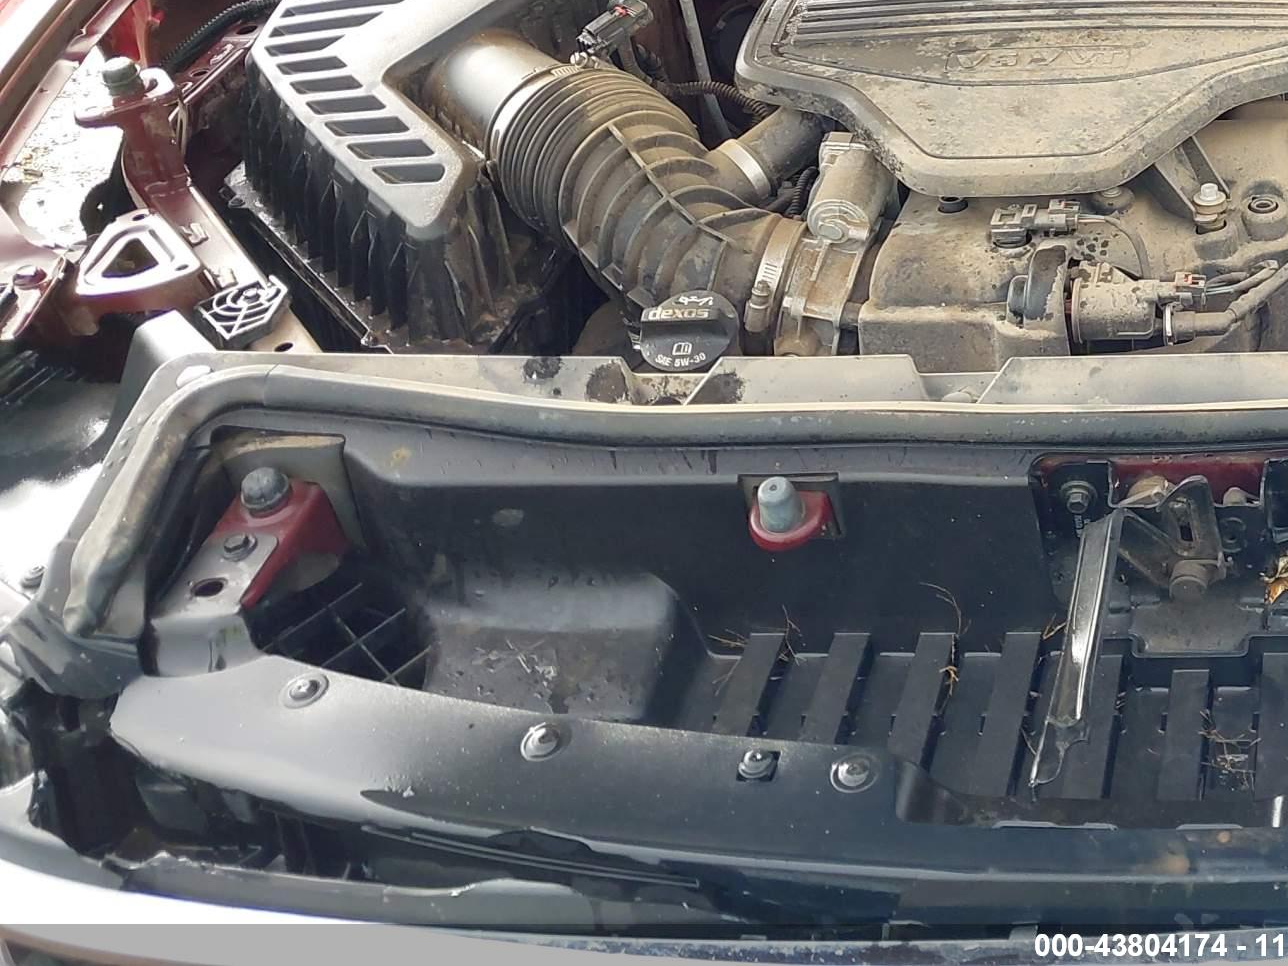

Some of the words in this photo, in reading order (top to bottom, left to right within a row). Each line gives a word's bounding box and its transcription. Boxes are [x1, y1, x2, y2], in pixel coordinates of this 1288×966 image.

[648, 306, 709, 320] dexos
[655, 354, 672, 366] SAE
[674, 352, 706, 367] 5W-30
